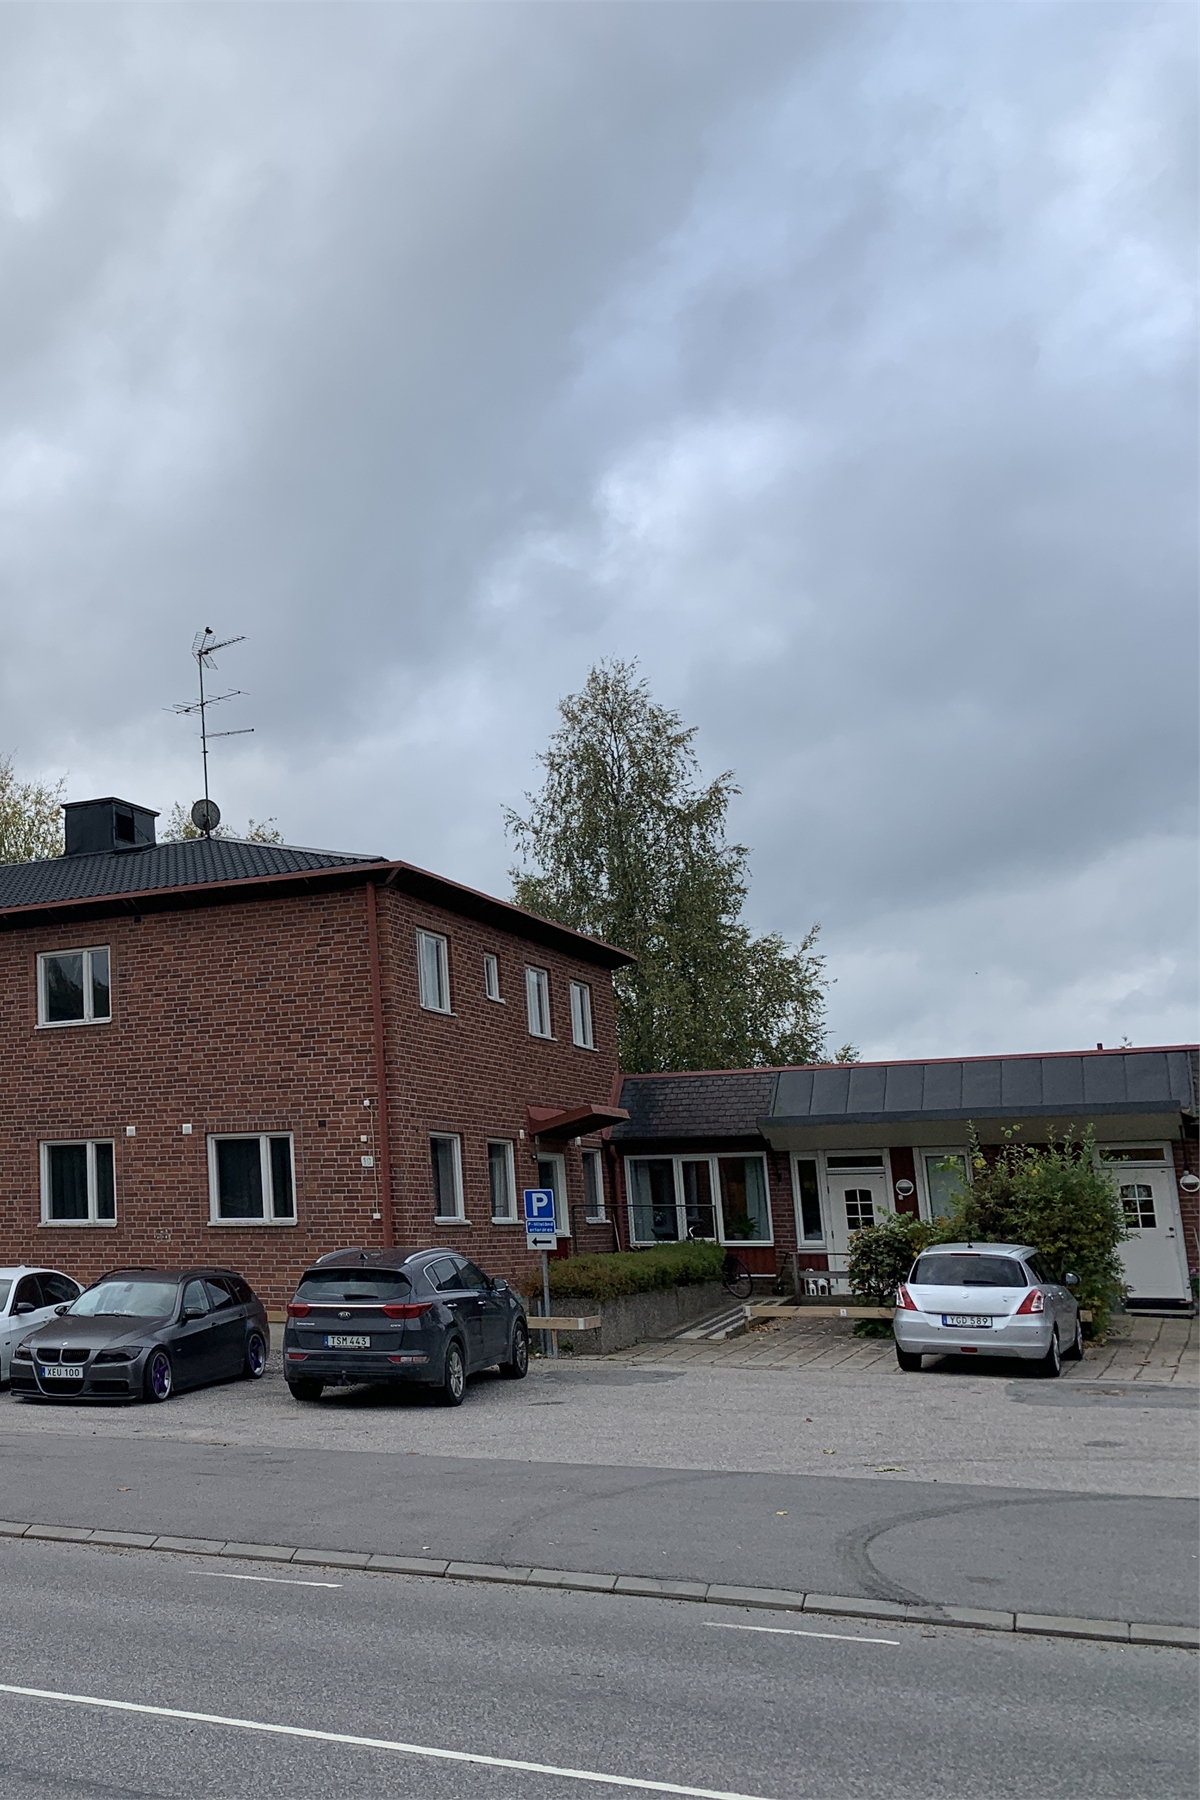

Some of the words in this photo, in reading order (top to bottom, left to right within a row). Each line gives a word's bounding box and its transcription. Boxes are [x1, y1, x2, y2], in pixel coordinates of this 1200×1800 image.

[531, 1193, 548, 1216] P
[950, 1316, 967, 1325] YGD
[970, 1316, 988, 1326] 589
[331, 1336, 348, 1345] TSM
[350, 1336, 367, 1345] 443
[47, 1368, 61, 1377] XEU
[64, 1368, 80, 1377] 100
